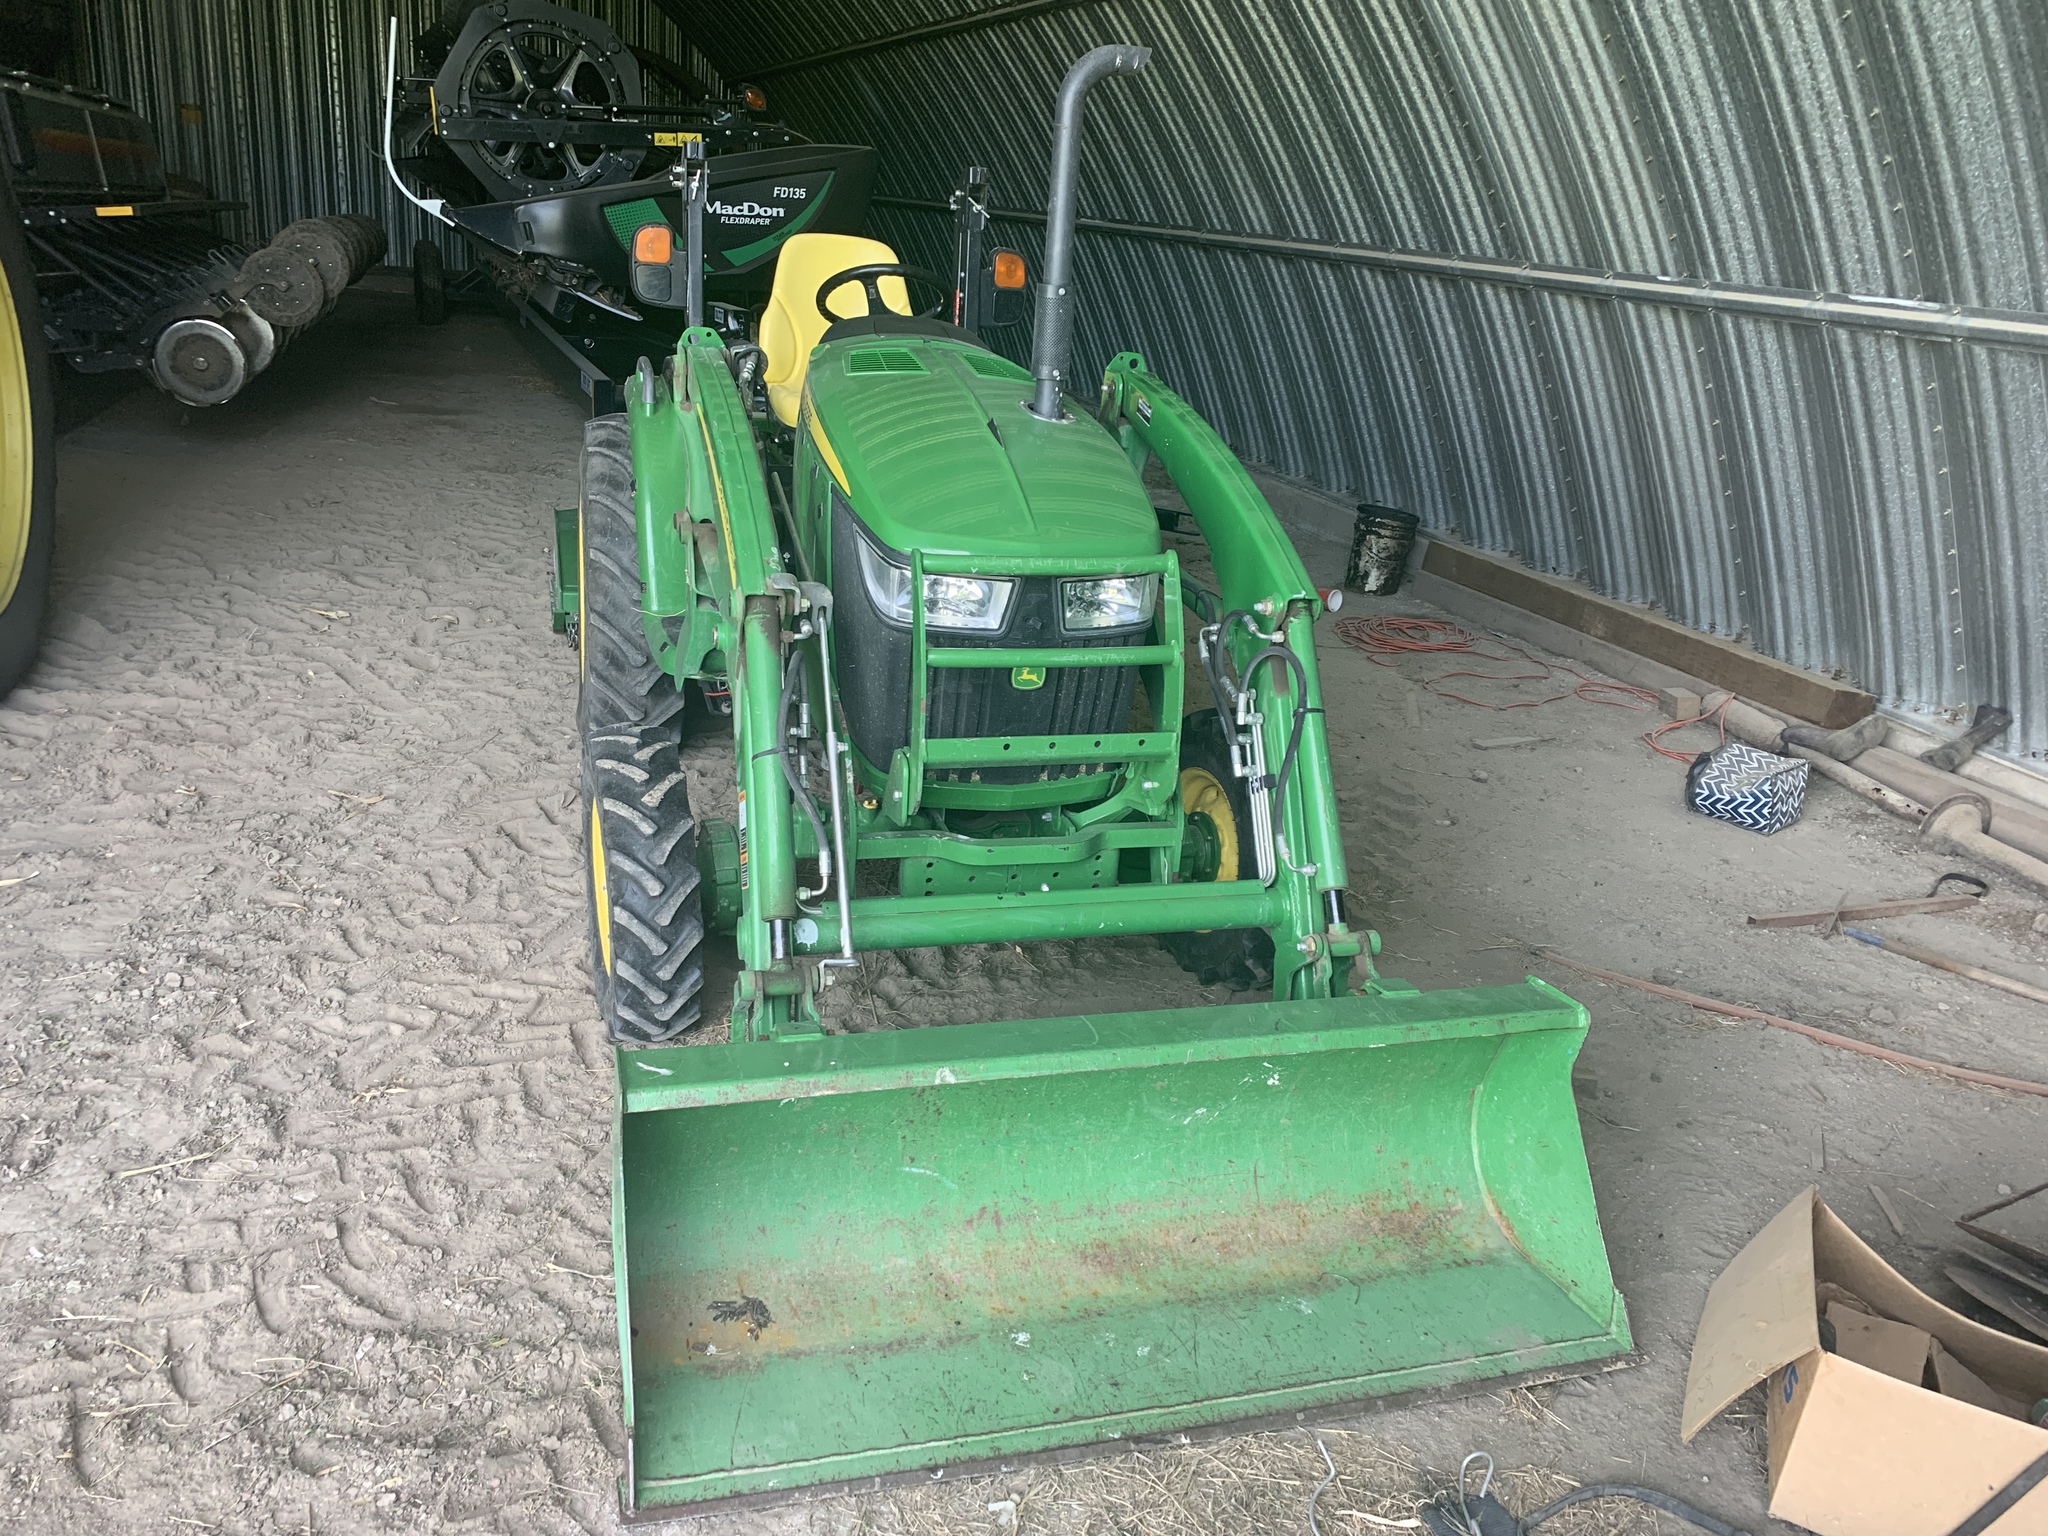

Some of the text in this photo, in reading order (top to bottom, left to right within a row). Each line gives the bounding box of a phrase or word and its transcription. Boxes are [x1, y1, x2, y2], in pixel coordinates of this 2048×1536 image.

[773, 186, 807, 199] FD135
[705, 200, 785, 217] MacDon
[720, 216, 770, 226] FLEXDRAPER
